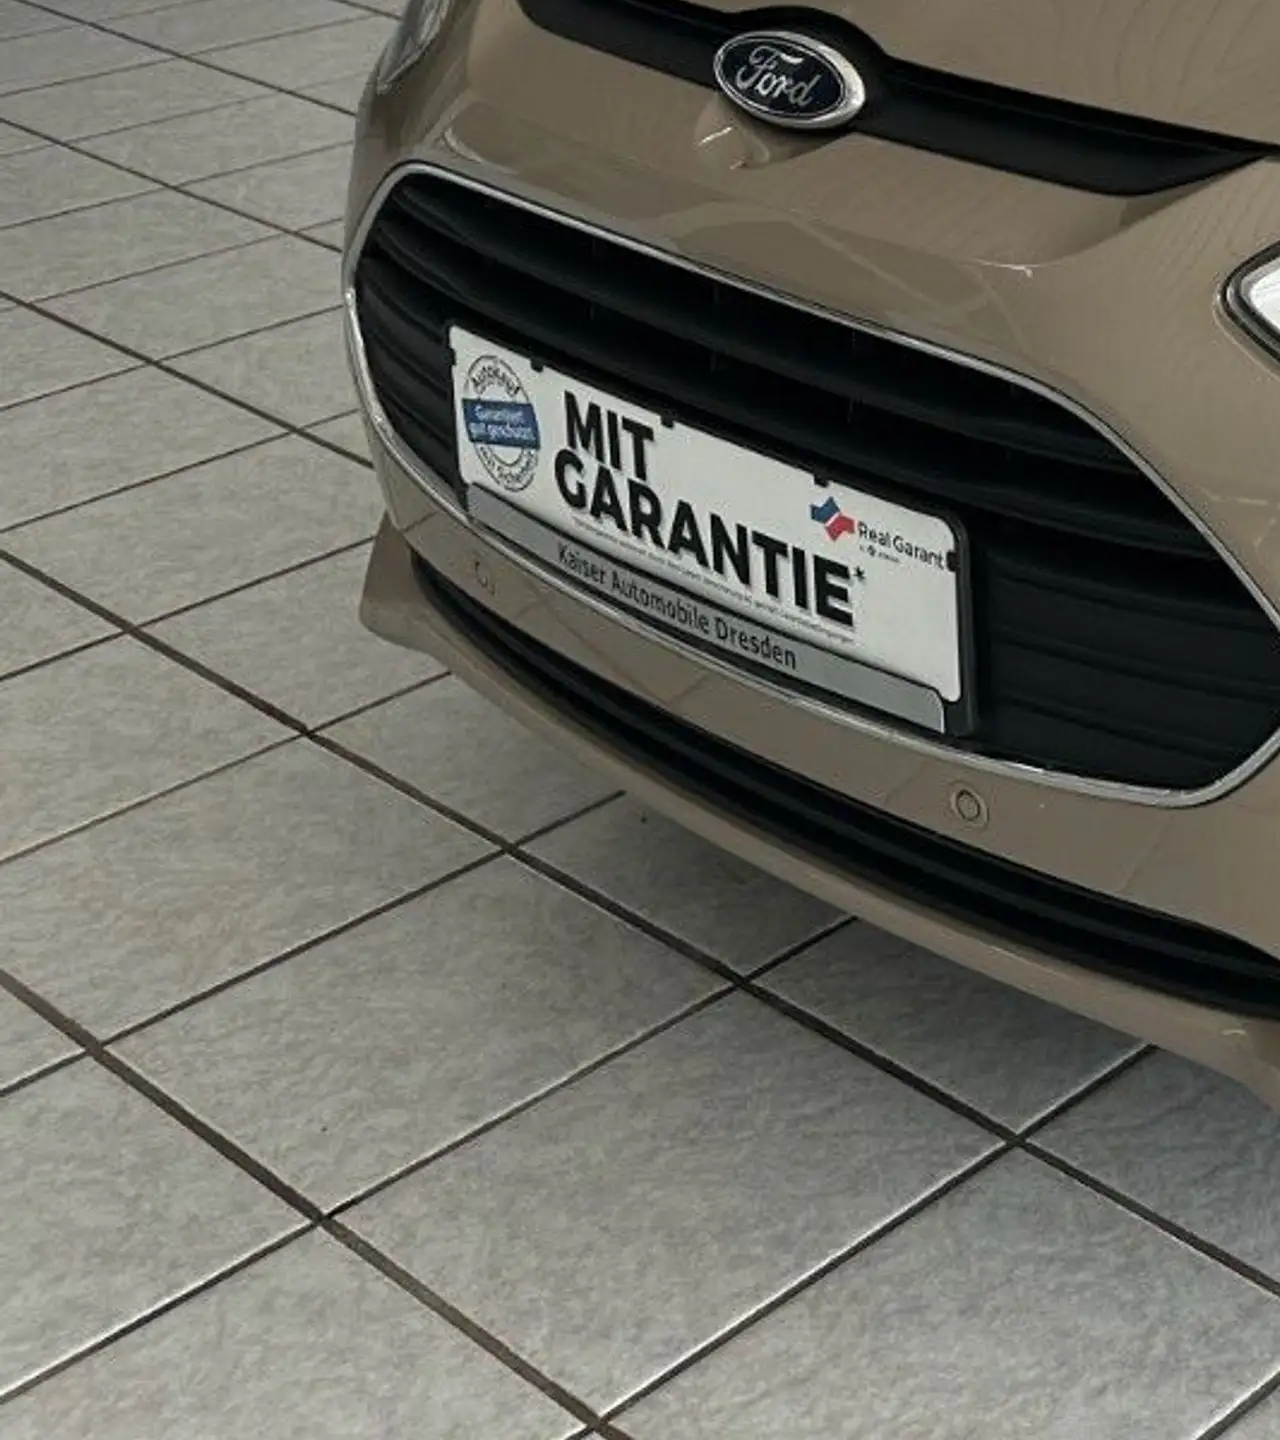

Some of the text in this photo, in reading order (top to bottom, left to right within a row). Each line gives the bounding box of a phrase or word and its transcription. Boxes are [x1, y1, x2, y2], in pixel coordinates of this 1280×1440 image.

[736, 45, 822, 107] Ford
[564, 390, 655, 482] MIT
[557, 540, 797, 670] Kaiser Automobile Dresden
